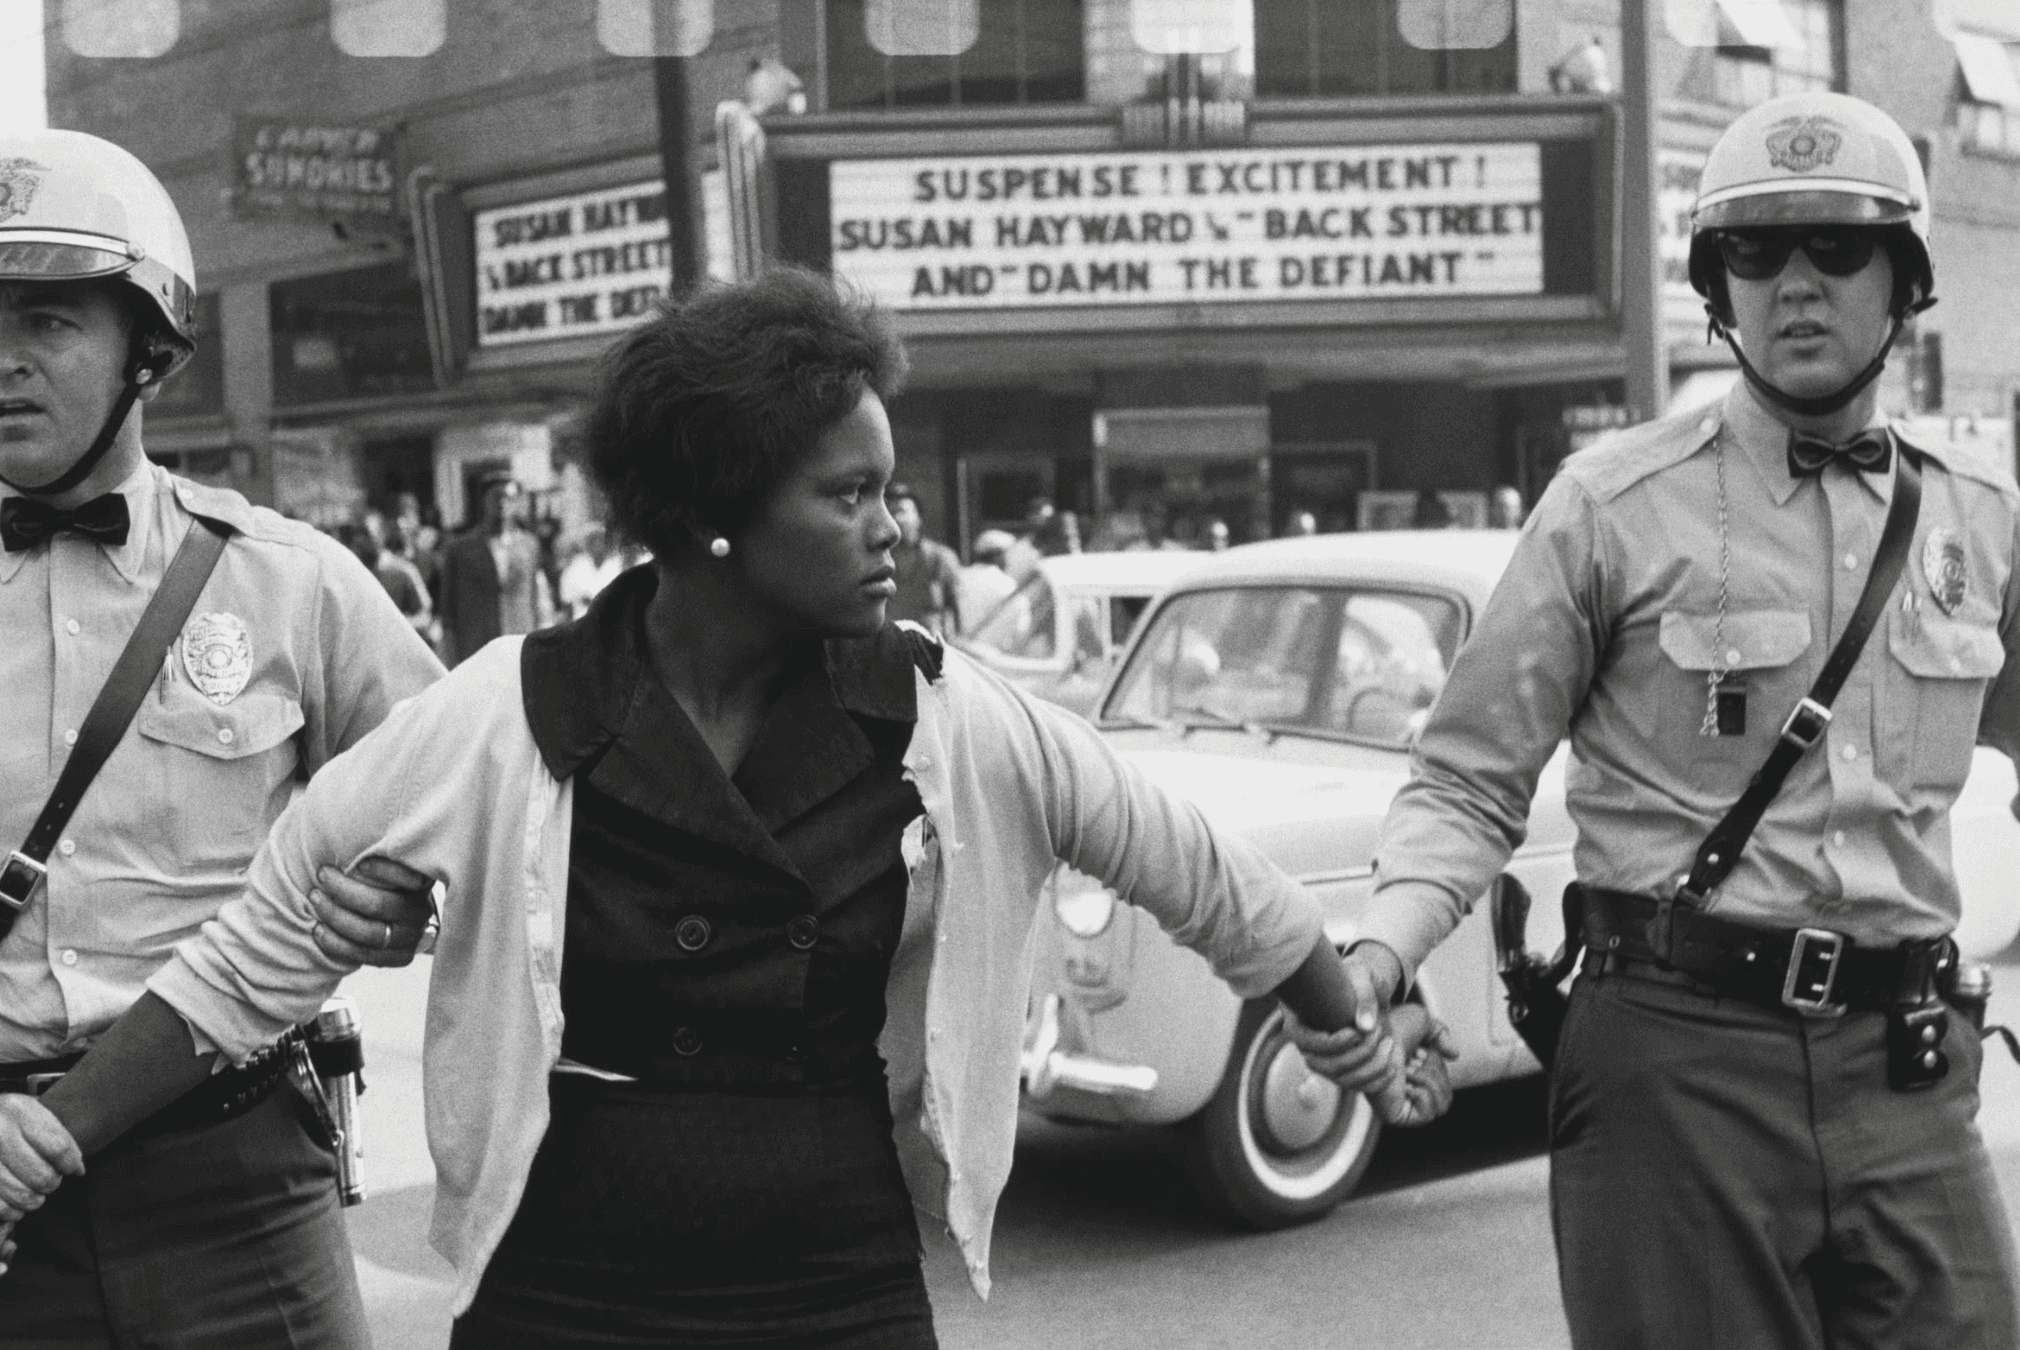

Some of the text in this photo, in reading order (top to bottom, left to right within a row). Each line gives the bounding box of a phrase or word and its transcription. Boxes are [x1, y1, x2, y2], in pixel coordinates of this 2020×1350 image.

[914, 166, 1140, 203] SUSPENSE
[1187, 155, 1460, 195] EXCITEMENT
[839, 216, 972, 251] SUSAN
[997, 210, 1194, 248] HAYWARD
[1386, 202, 1541, 238] STREET
[911, 265, 994, 298] AND
[1178, 256, 1259, 290] THE
